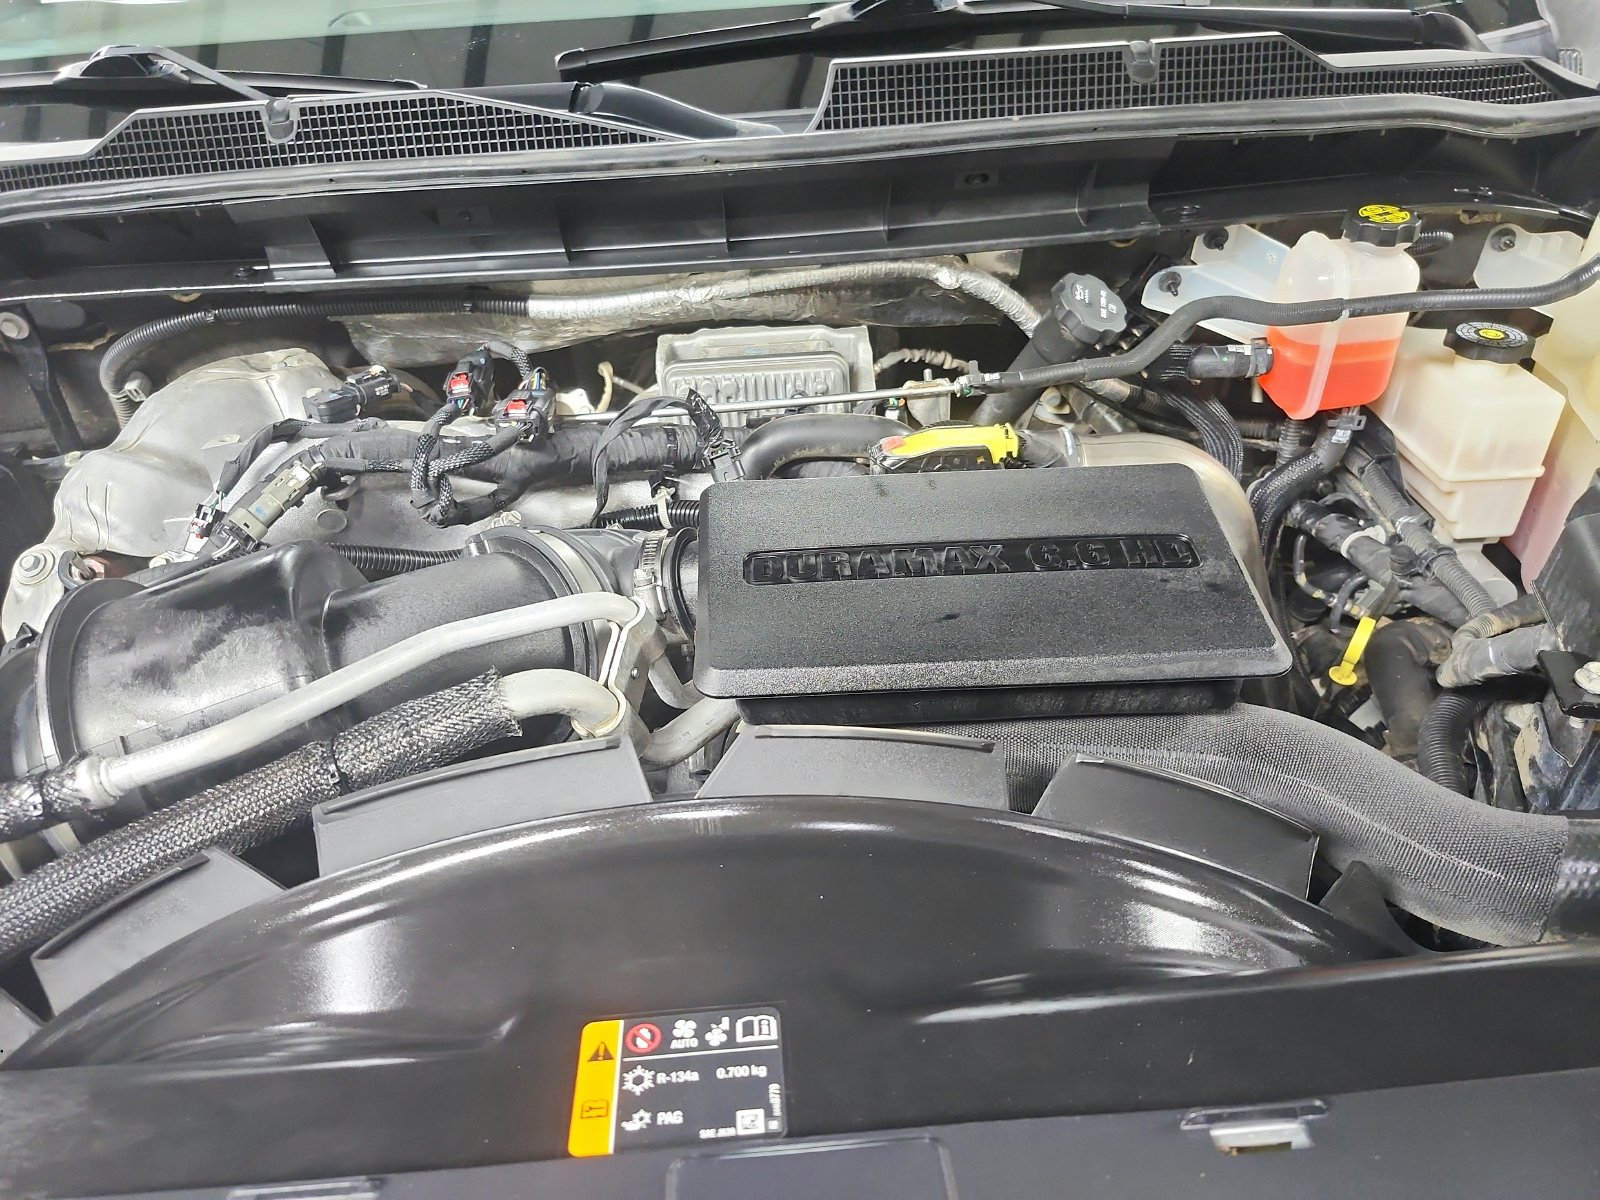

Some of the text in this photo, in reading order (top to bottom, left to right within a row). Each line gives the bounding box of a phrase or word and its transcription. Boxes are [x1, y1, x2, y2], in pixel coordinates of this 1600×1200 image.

[751, 538, 1193, 584] DURAMAX 6.6 HD
[670, 1038, 699, 1049] AUTO
[656, 1064, 767, 1084] R-134a 0.700 kg
[656, 1110, 684, 1126] PAG
